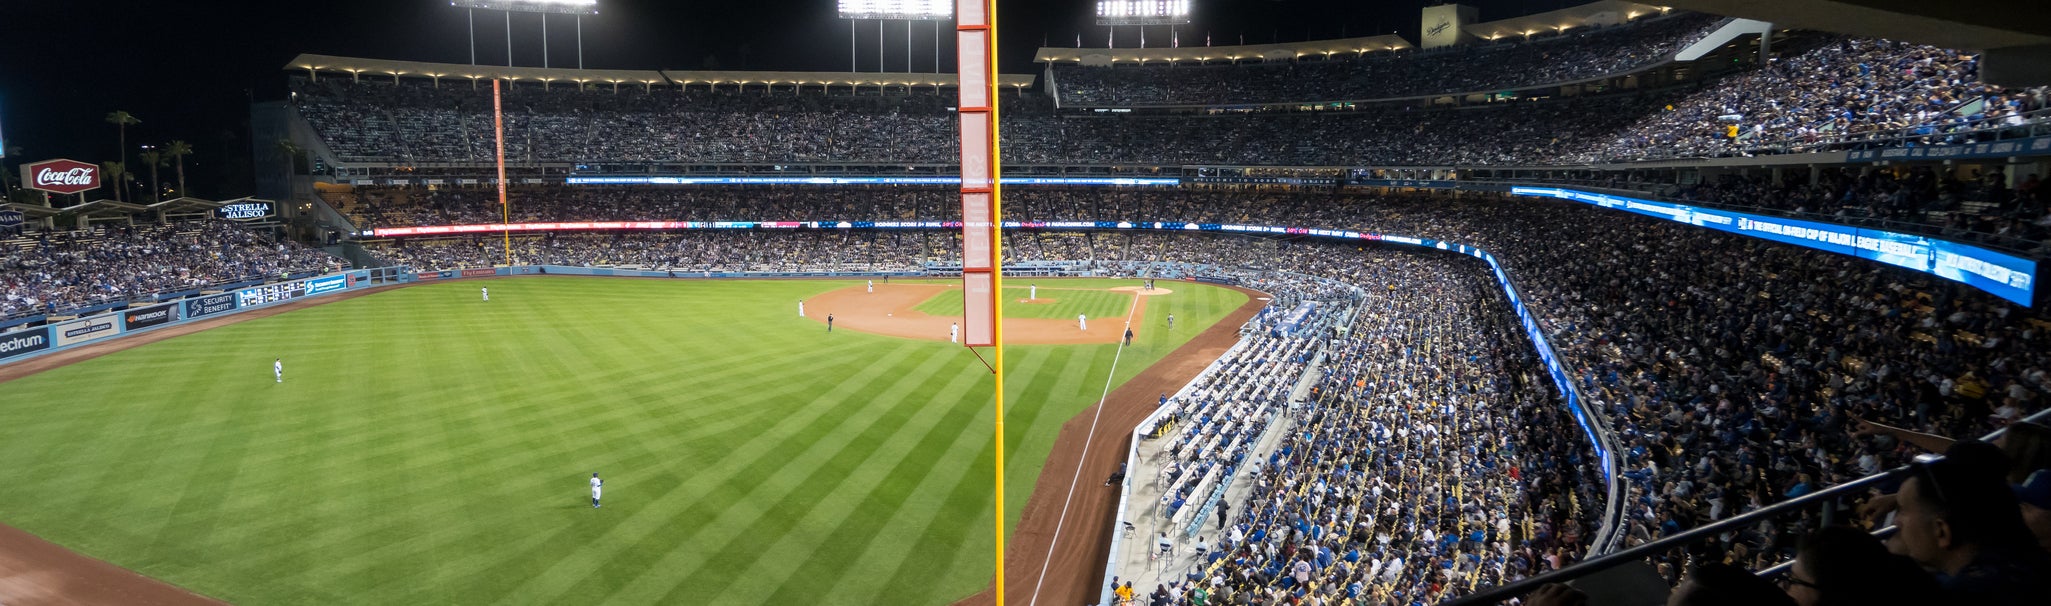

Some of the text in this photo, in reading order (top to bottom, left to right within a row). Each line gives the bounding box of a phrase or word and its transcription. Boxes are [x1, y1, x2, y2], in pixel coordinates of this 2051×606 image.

[37, 167, 94, 185] Coca-Cola
[221, 202, 269, 212] ESTRELLA
[226, 210, 264, 219] JALISCO
[204, 295, 233, 306] SECURITY
[204, 303, 229, 314] BENEFIT
[0, 335, 42, 352] ectrum
